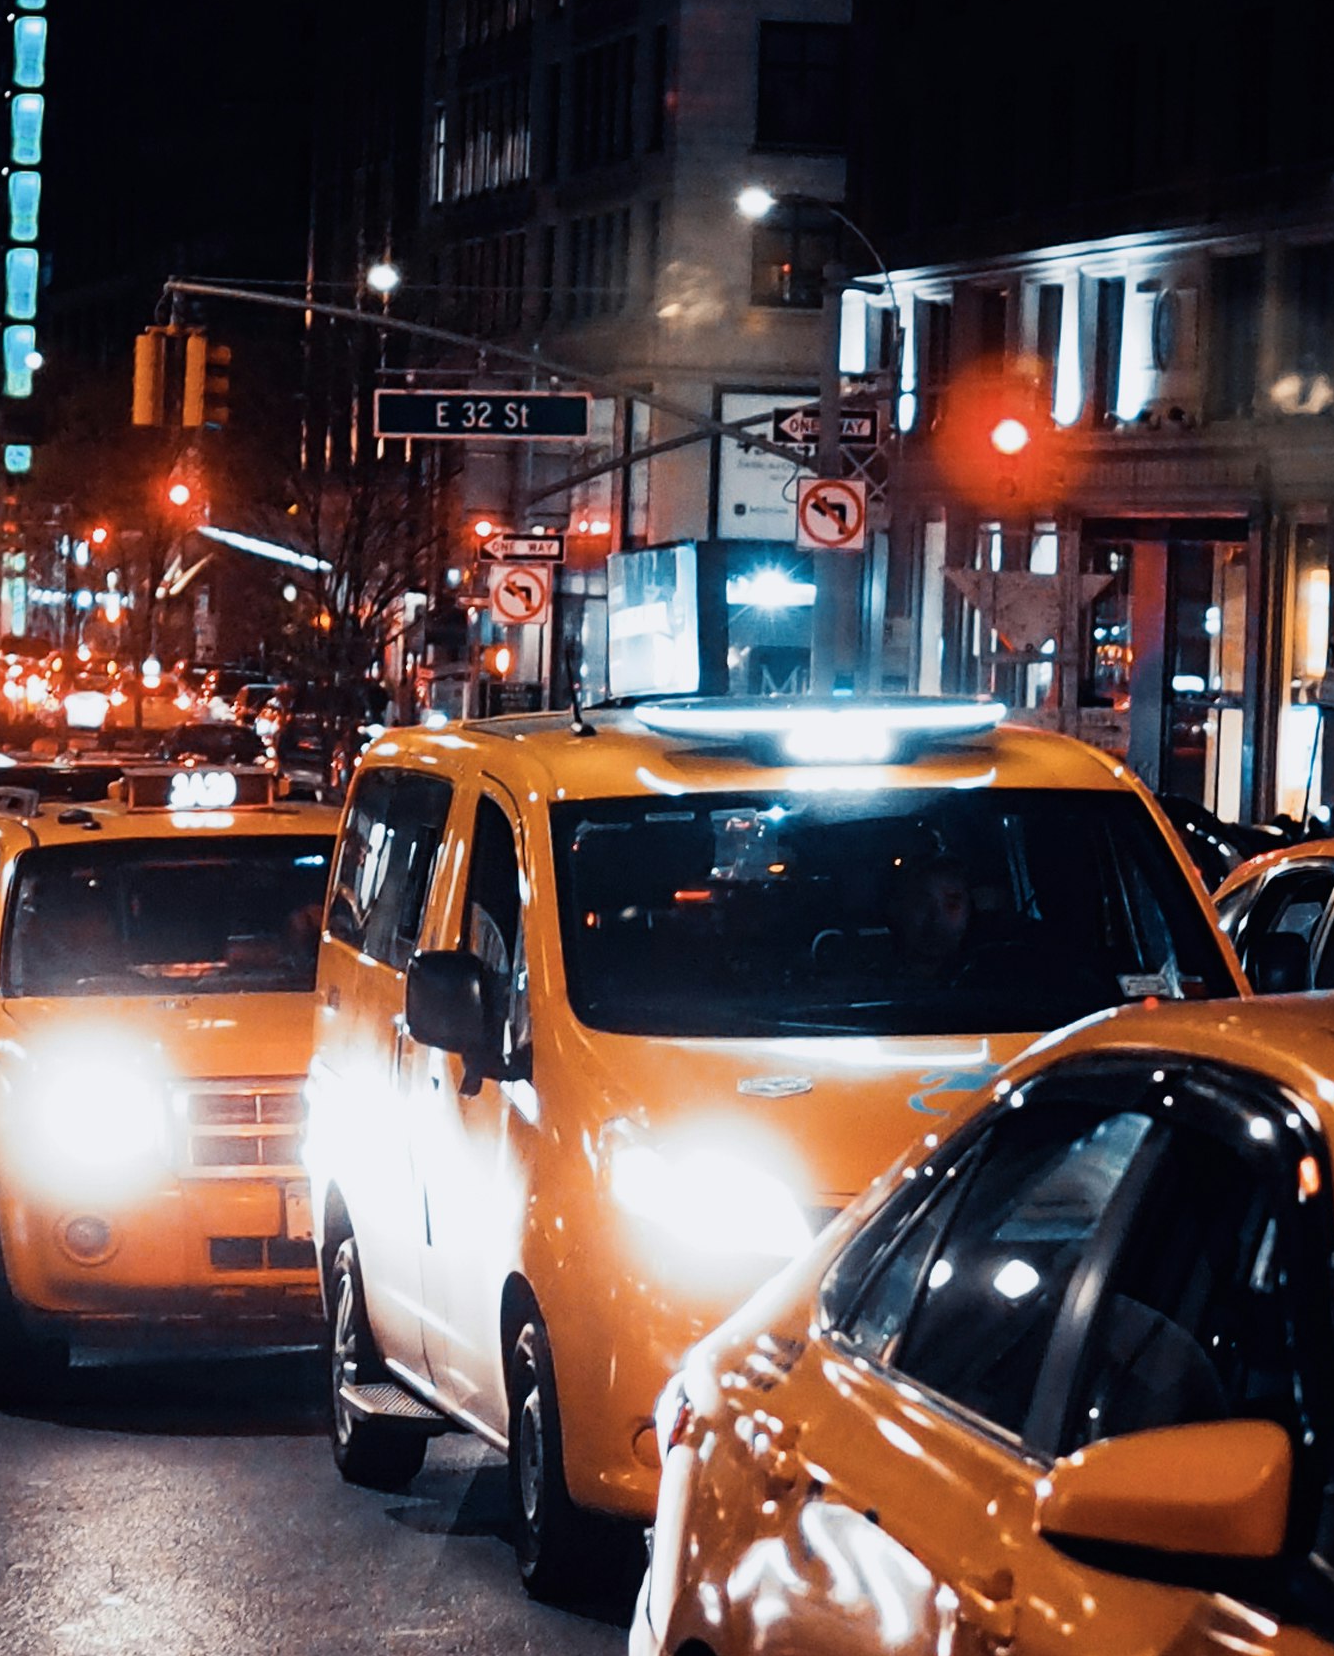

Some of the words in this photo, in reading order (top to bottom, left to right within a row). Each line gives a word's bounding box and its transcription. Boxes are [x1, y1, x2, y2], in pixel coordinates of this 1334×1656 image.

[435, 401, 450, 428] E
[462, 401, 493, 428] 32
[504, 401, 529, 428] St
[527, 543, 554, 554] WAY
